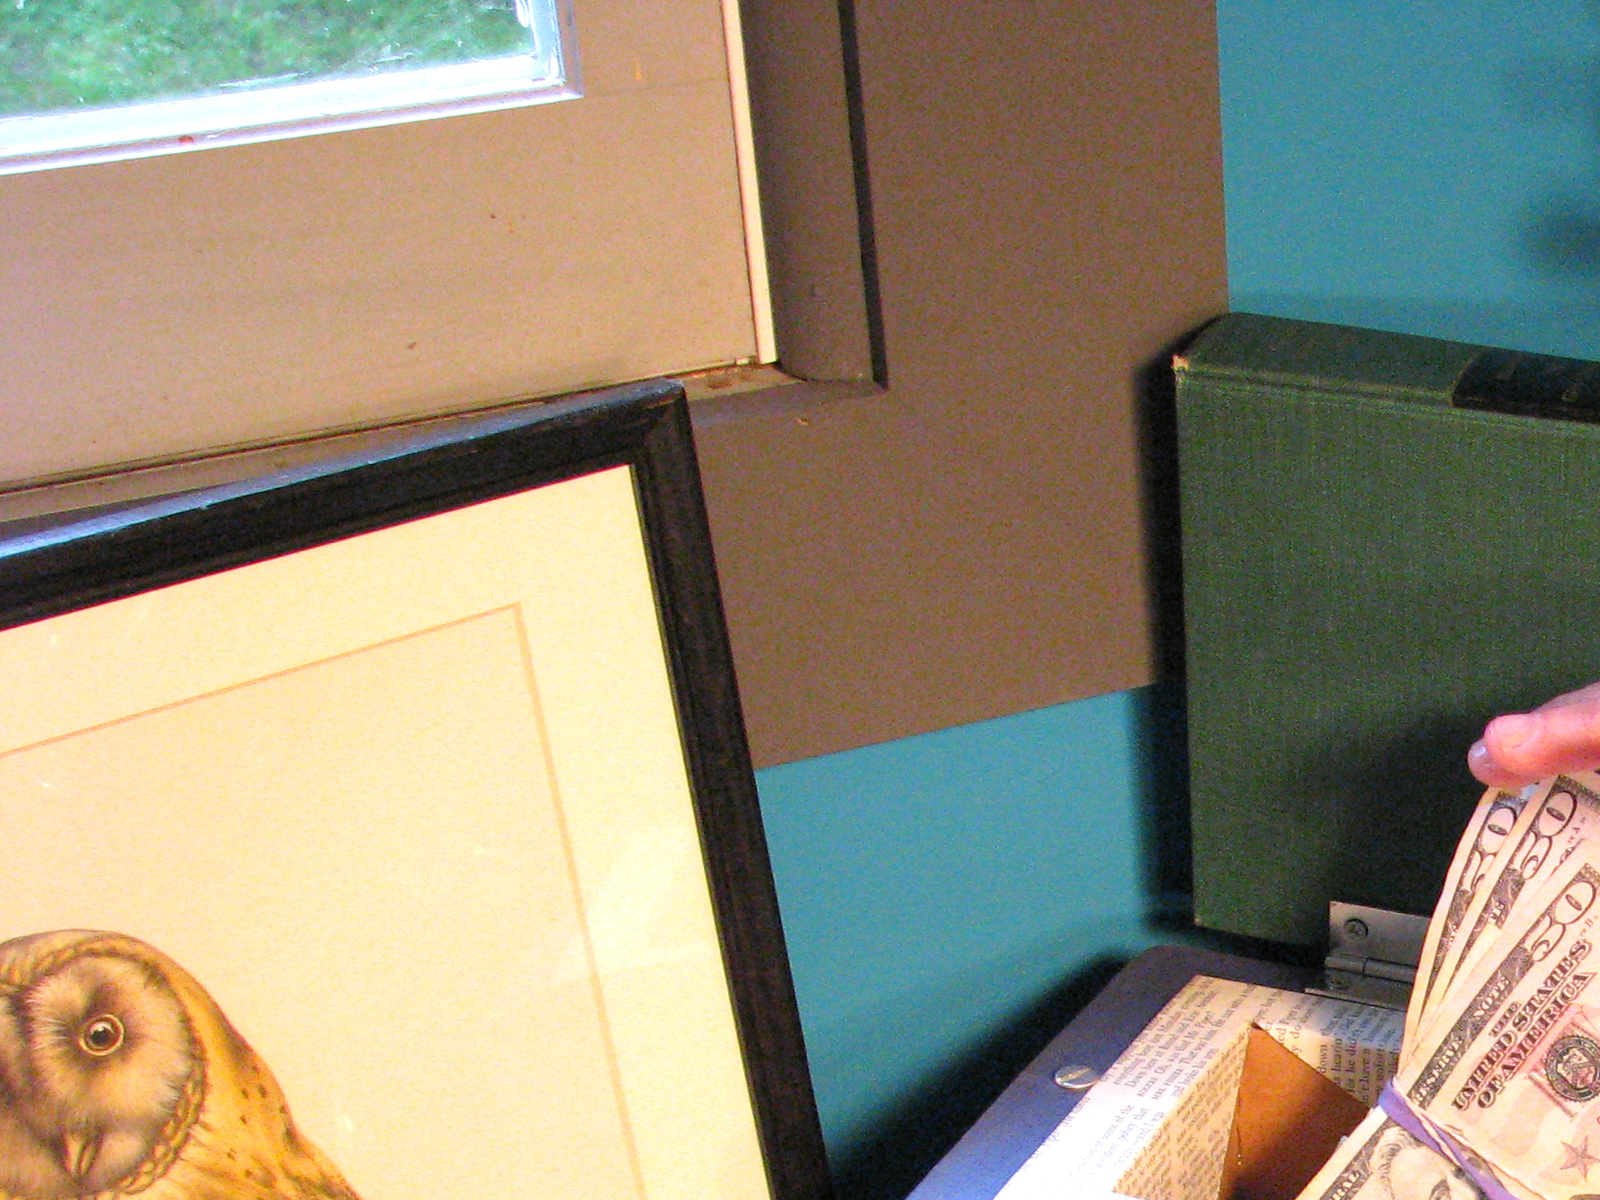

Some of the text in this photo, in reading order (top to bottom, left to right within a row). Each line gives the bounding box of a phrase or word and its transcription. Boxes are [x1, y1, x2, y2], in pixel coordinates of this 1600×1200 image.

[1512, 790, 1577, 880] 50
[1525, 880, 1597, 963] 50
[1451, 938, 1592, 1111] UNITED STATES
[1473, 975, 1510, 1021] NOTE
[1476, 971, 1598, 1109] OF AMERICA
[1488, 1001, 1522, 1040] THE
